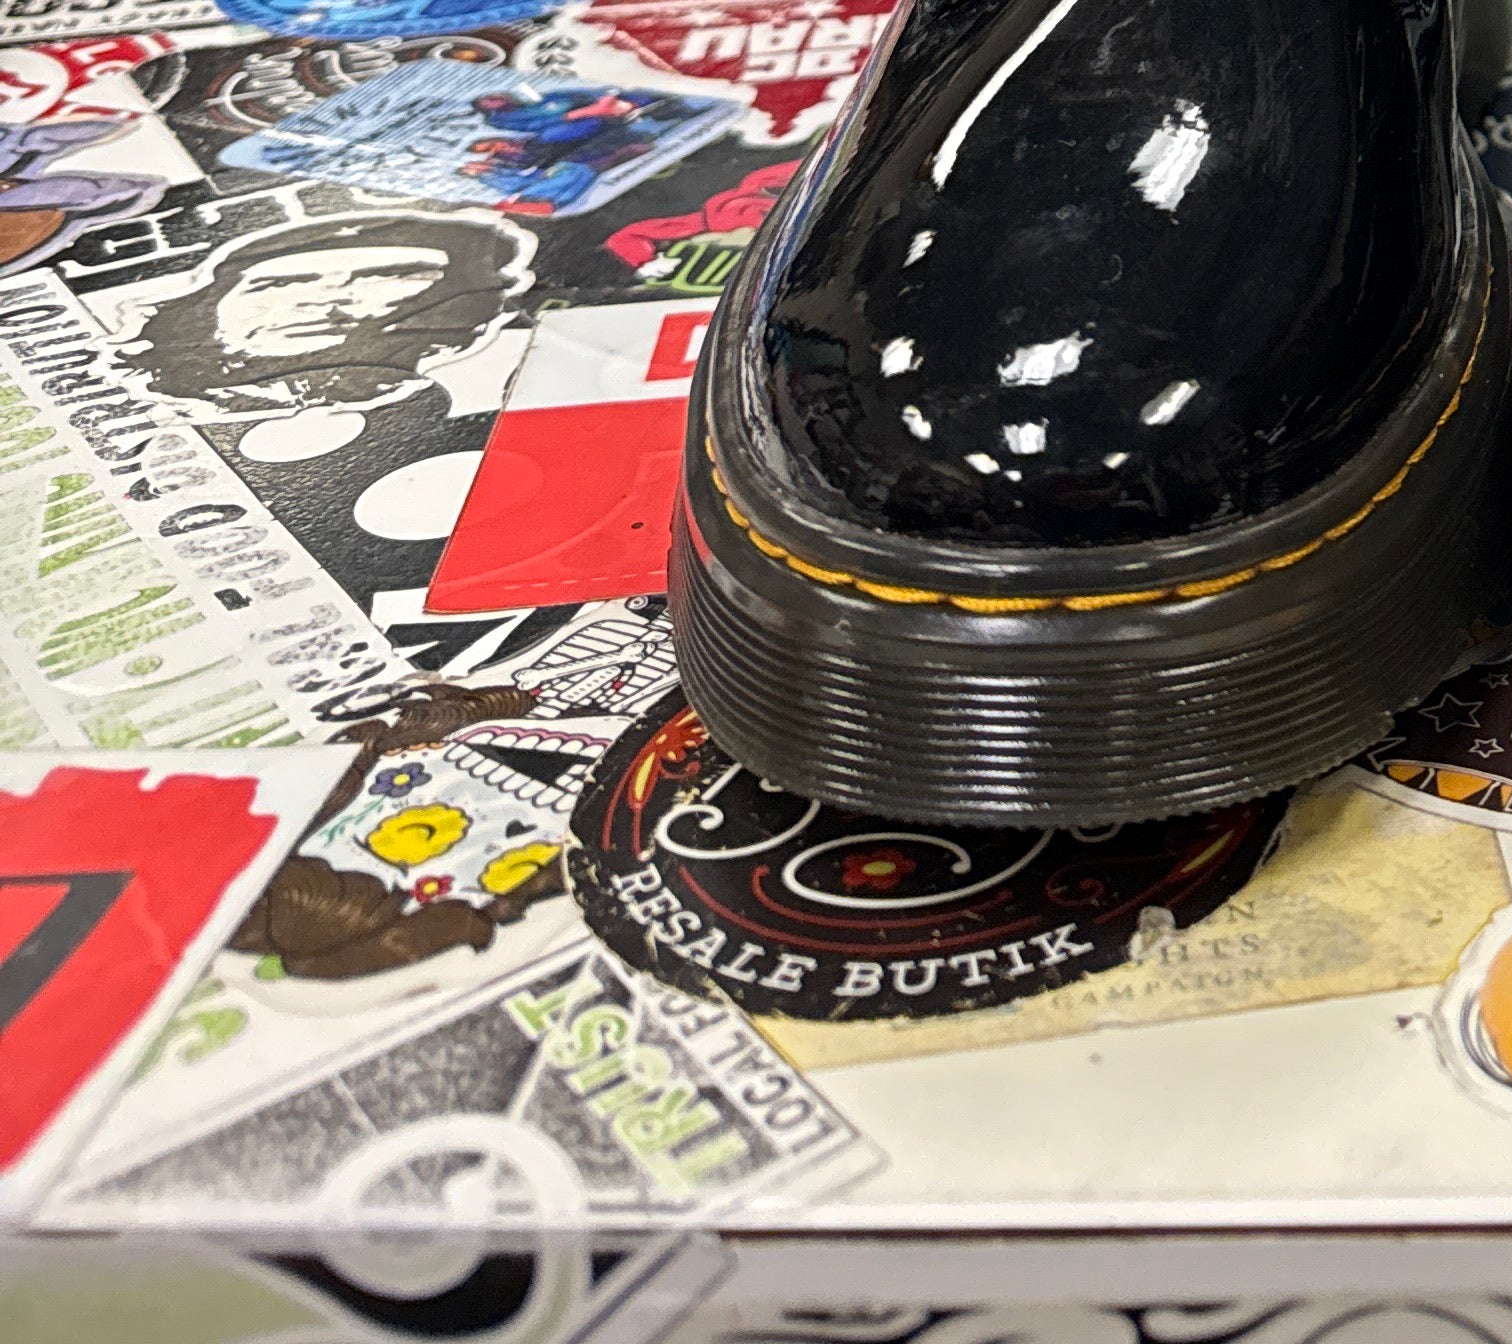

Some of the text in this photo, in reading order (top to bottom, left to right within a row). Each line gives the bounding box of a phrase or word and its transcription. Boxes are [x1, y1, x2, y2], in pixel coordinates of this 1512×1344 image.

[676, 14, 880, 62] RAU
[609, 862, 1095, 999] RESALE BUTIK
[1050, 966, 1265, 1010] CAMPAIGN
[503, 976, 749, 1196] TRUST
[708, 1030, 838, 1153] LOCAL
